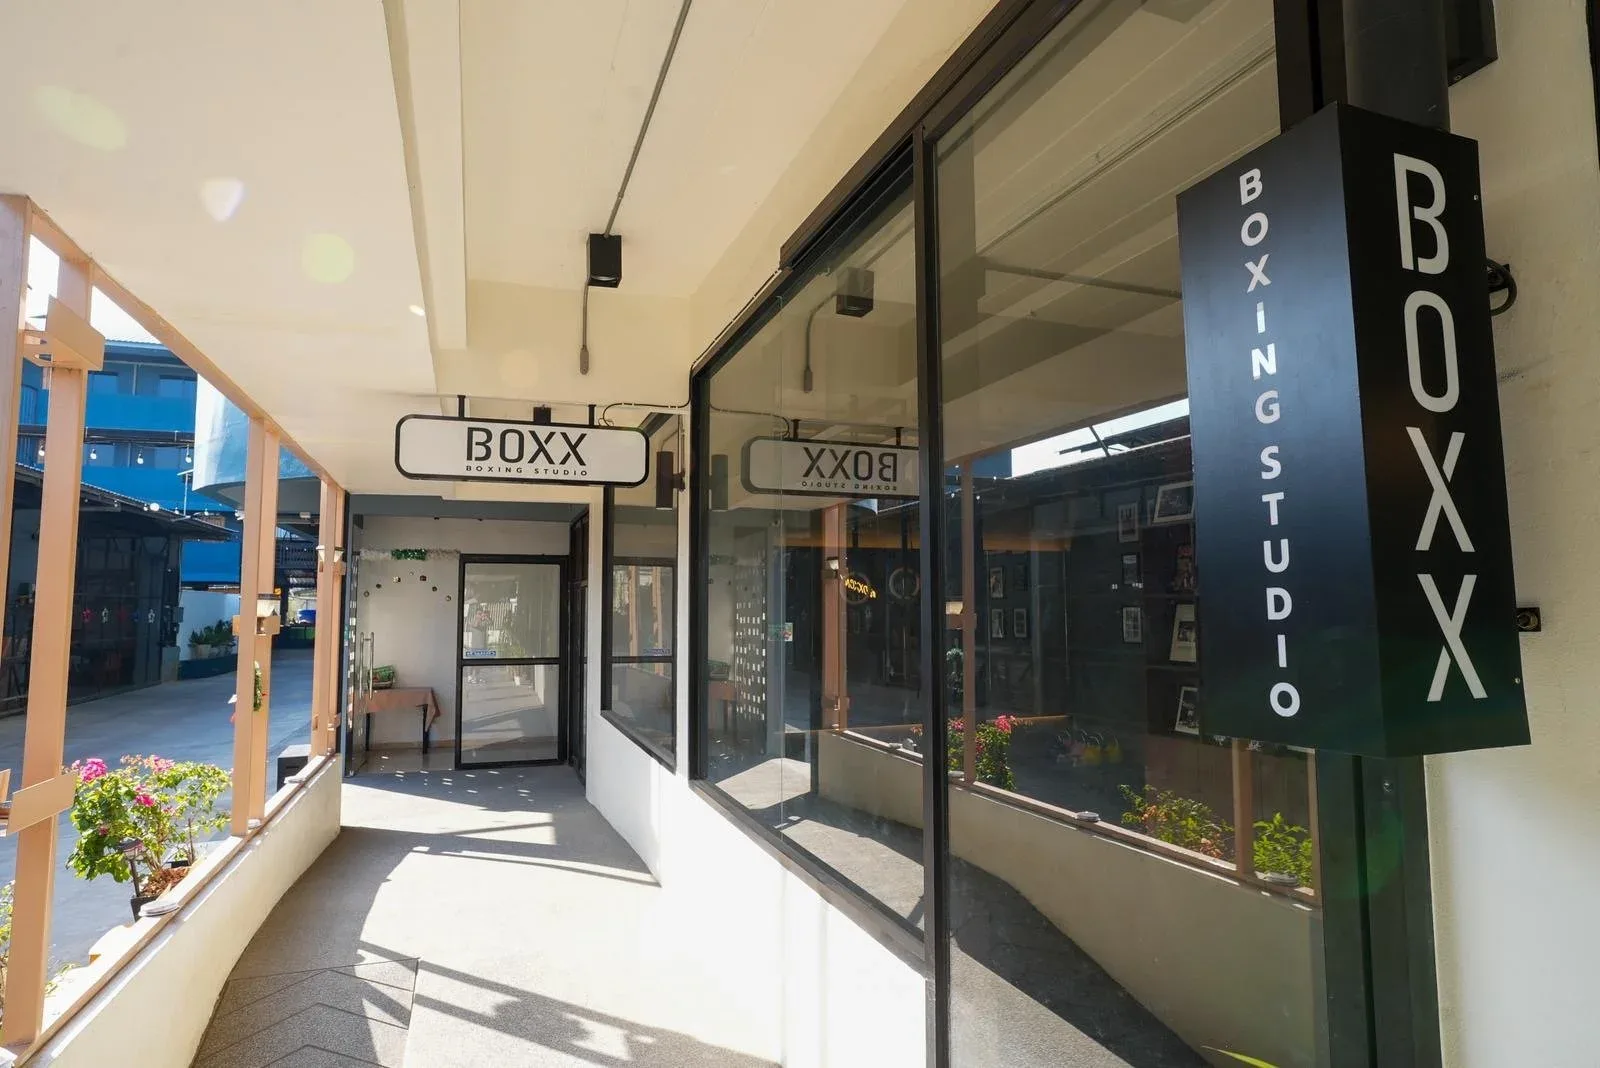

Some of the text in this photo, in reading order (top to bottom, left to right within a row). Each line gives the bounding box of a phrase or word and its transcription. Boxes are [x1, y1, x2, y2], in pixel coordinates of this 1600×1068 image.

[466, 427, 588, 466] BOXX
[466, 465, 588, 476] BOXING STUDIO
[1239, 168, 1301, 718] BOXING STUDIO
[1393, 152, 1488, 702] BOXX
